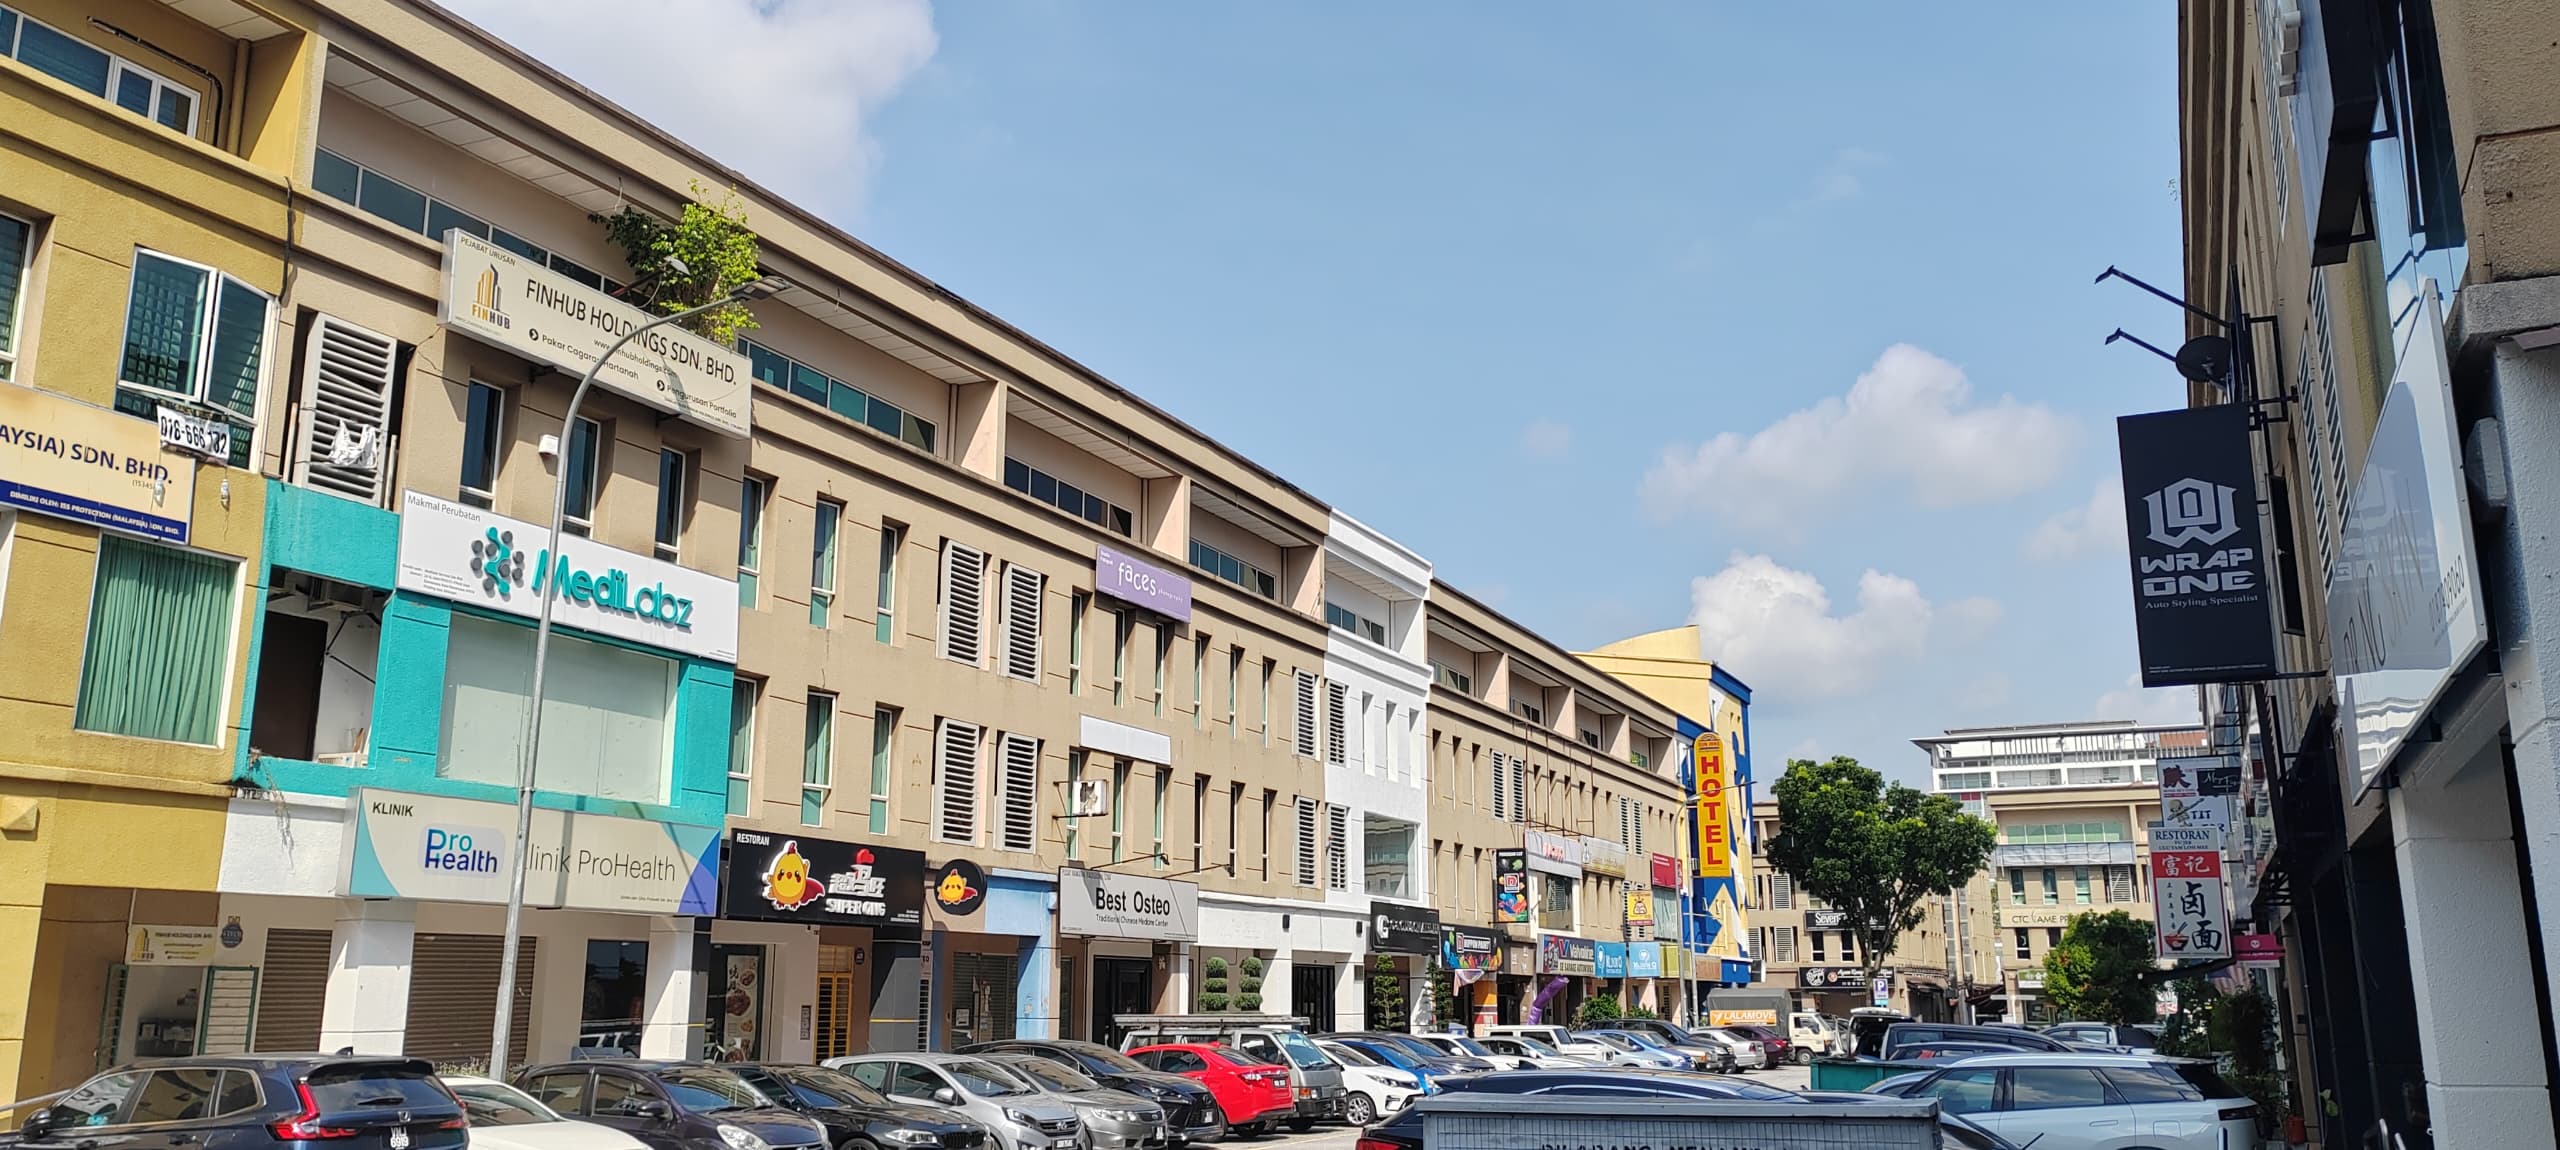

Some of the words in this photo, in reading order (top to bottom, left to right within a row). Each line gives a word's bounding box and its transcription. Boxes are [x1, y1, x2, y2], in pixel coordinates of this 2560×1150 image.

[461, 237, 488, 254] PEJABAT
[489, 248, 516, 267] URUSAN
[526, 278, 586, 322] FINHUB
[671, 342, 702, 372] SDN.
[706, 357, 737, 386] BHD.
[542, 335, 566, 352] Pakar
[567, 344, 602, 365] Cagara
[667, 384, 709, 408] Pengurusan
[709, 401, 737, 419] Portfolio
[70, 443, 121, 472] SDN.
[126, 457, 172, 485] BHD.
[71, 504, 112, 519] PROTECTION
[407, 494, 441, 513] Makmal
[441, 503, 482, 523] Perubatan
[2140, 547, 2254, 574] WRAP
[531, 548, 694, 630] MediLabz
[1118, 561, 1157, 597] faces
[2142, 570, 2257, 597] ONE
[2145, 599, 2170, 609] Auto
[2171, 597, 2208, 608] Styling
[2209, 594, 2259, 606] Specialist
[372, 801, 414, 818] KLINIK
[1700, 755, 1723, 865] HOTEL
[426, 828, 473, 853] Pro
[736, 832, 770, 847] RESTORAN
[2155, 830, 2210, 841] RESTORAN
[425, 848, 498, 874] Health
[519, 844, 571, 874] linik
[577, 849, 676, 883] ProHealth
[2162, 854, 2211, 877] 富记
[824, 897, 862, 915] SUPER
[1095, 887, 1127, 912] Best
[1133, 890, 1170, 916] Osteo
[1723, 1010, 1776, 1020] LALAMOVE
